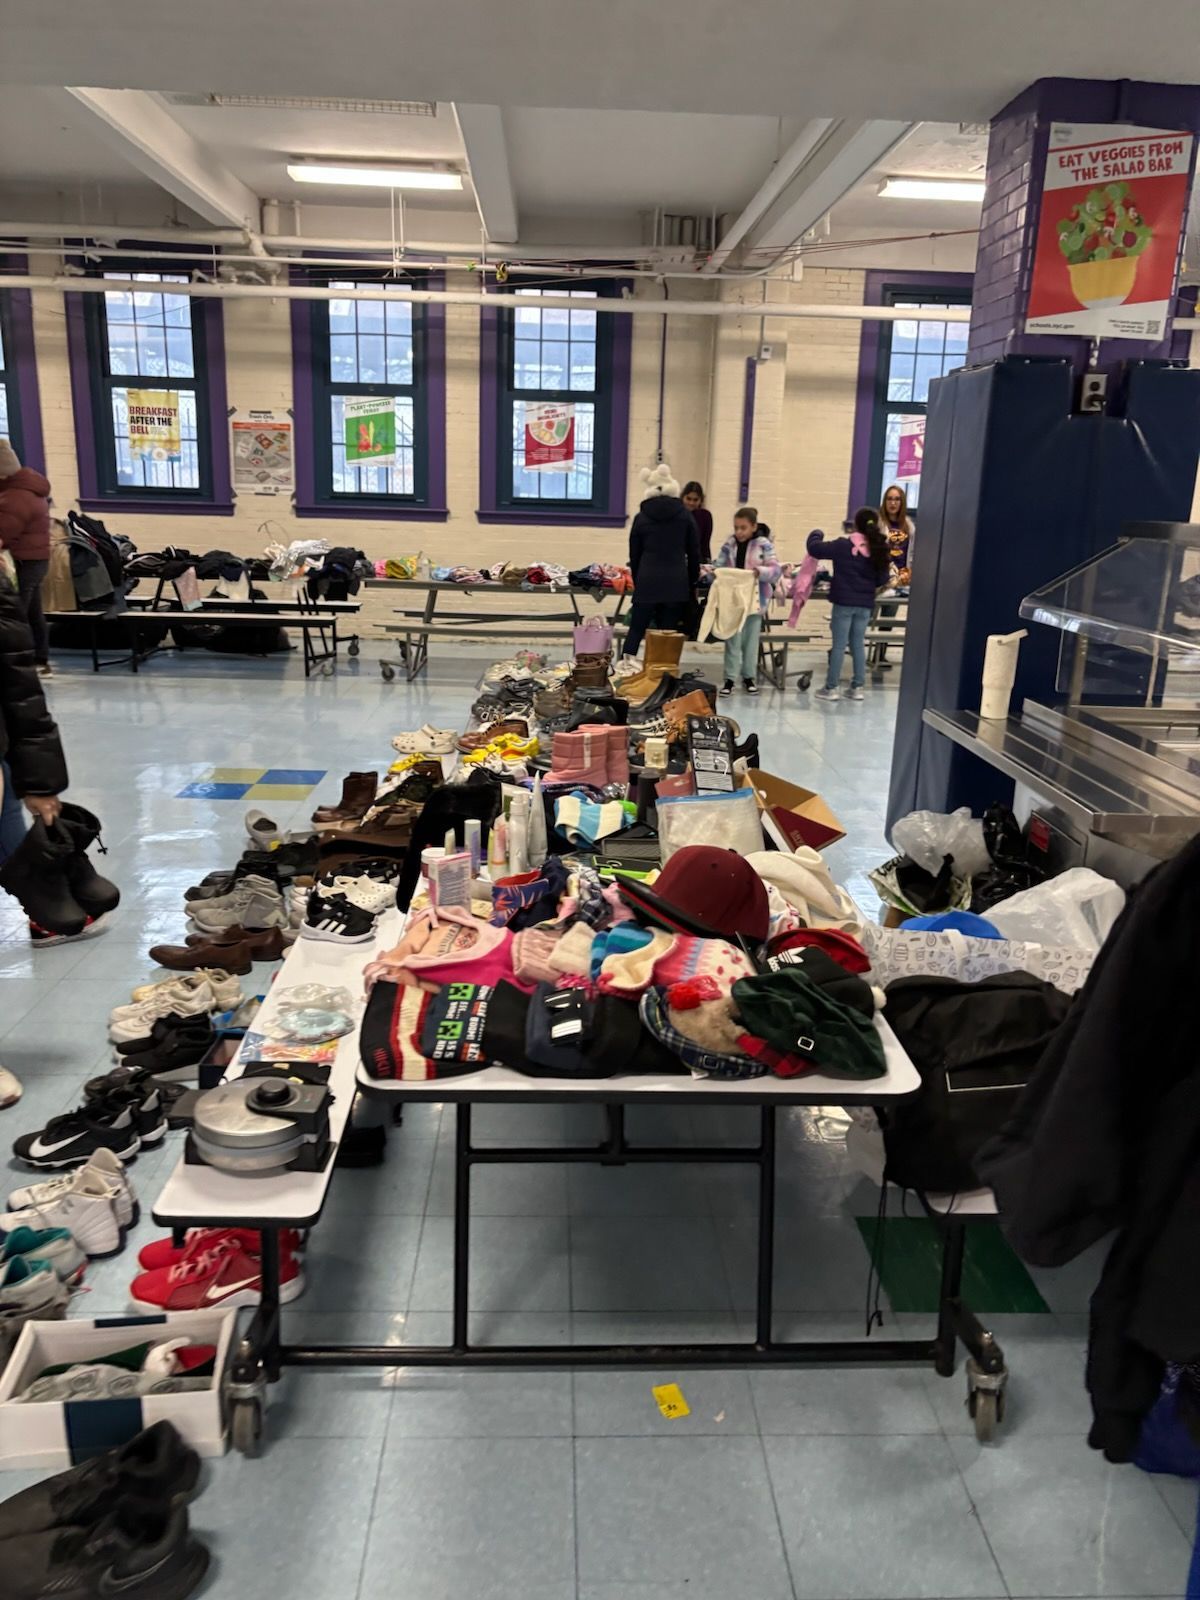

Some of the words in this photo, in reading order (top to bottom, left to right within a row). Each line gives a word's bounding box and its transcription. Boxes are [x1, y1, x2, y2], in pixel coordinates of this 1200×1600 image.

[1059, 153, 1083, 168] EAT
[1089, 145, 1145, 163] VEGGIES
[1148, 141, 1183, 157] FROM
[1072, 167, 1099, 181] THE
[1103, 161, 1145, 177] SALAD
[1148, 157, 1173, 172] BAR
[129, 406, 177, 417] BREAKFAST
[130, 415, 155, 426] AFTER
[156, 417, 172, 426] THE
[130, 425, 149, 435] BELL
